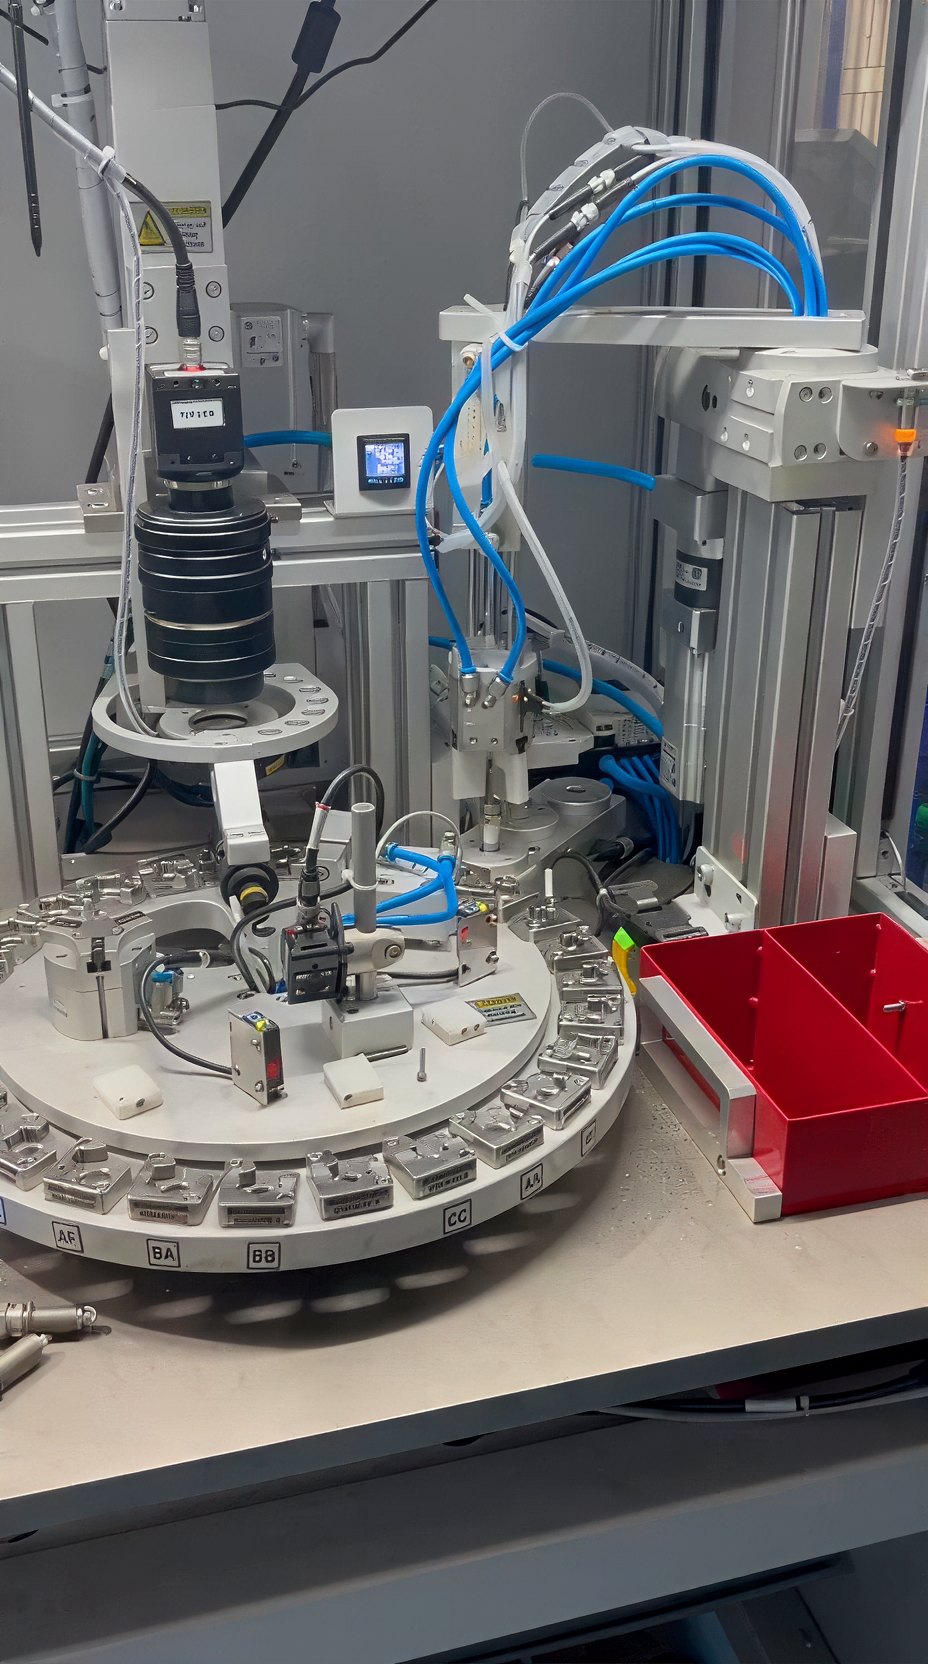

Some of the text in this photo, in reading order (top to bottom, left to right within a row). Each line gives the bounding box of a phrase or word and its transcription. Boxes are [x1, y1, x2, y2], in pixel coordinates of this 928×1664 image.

[448, 1208, 467, 1227] CC
[58, 1229, 76, 1244] AF
[152, 1246, 176, 1261] BA
[252, 1249, 276, 1263] BB
